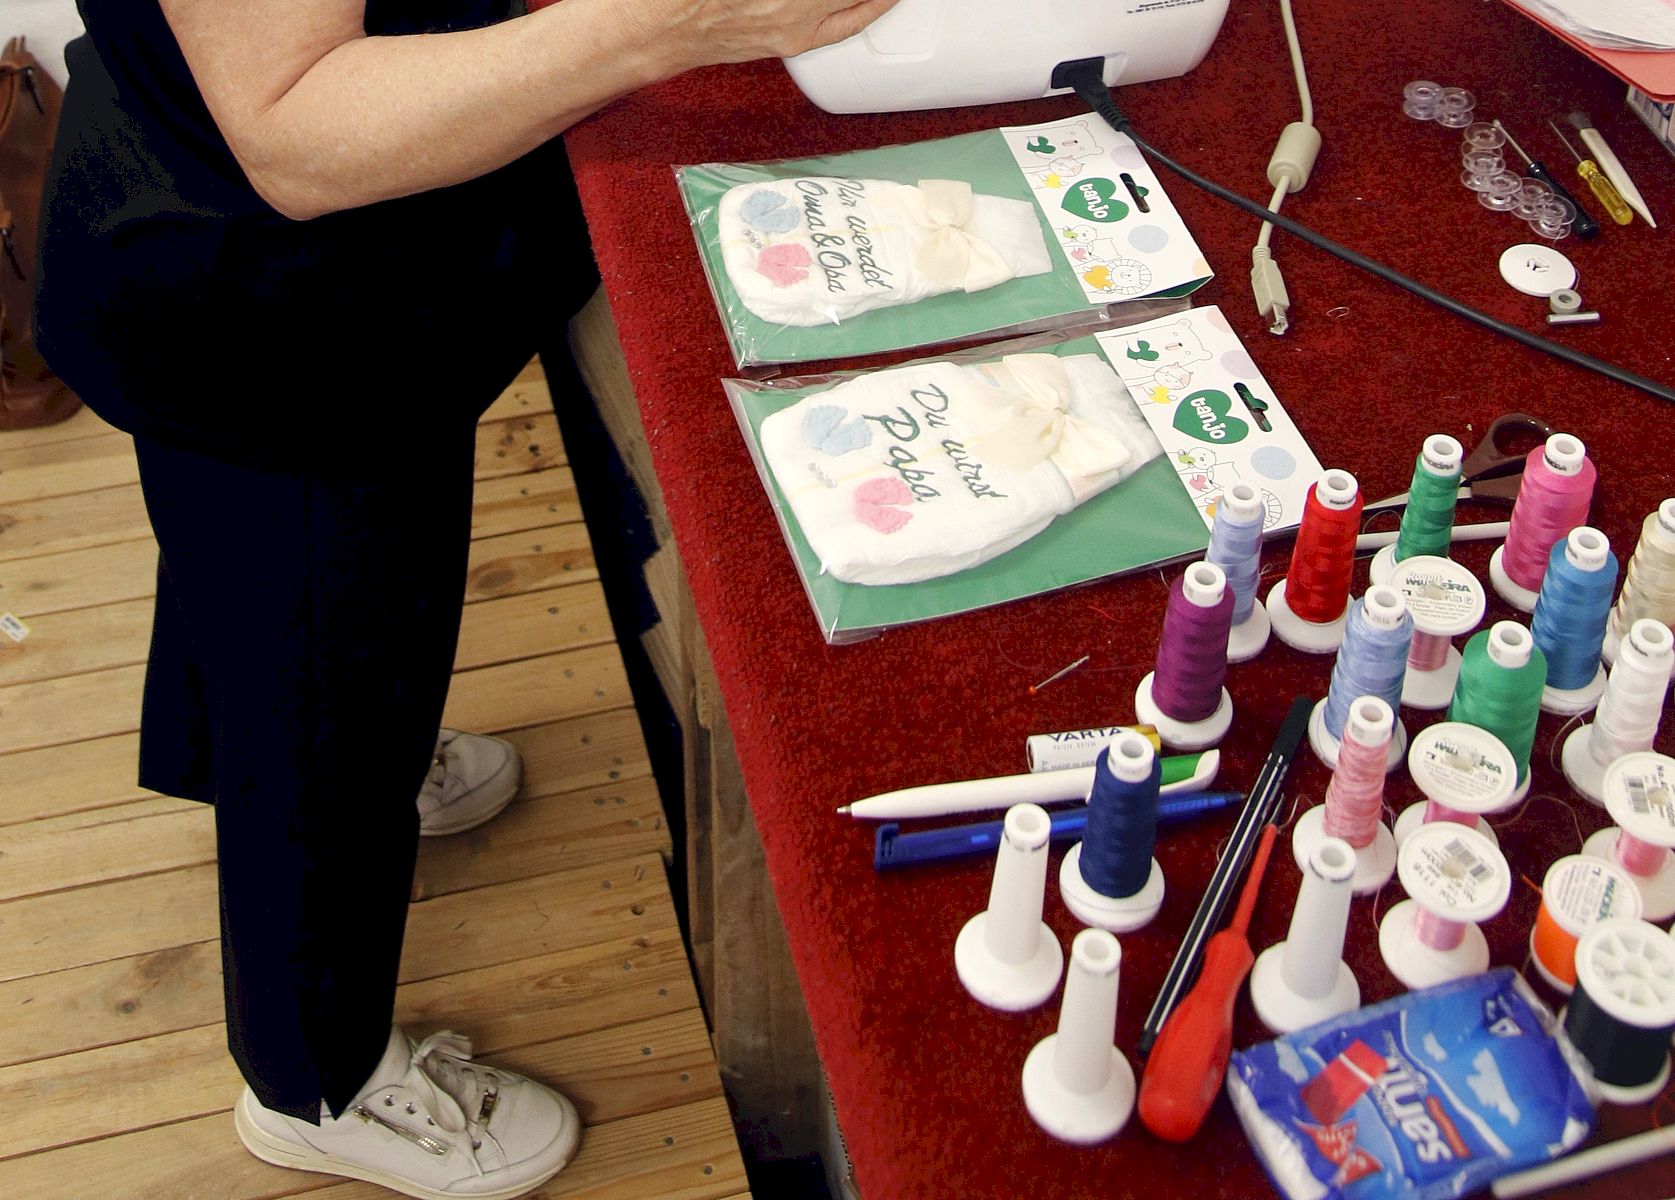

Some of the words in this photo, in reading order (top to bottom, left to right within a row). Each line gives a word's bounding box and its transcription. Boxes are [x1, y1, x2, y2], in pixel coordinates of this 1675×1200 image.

[1079, 183, 1109, 221] tanjo
[911, 383, 952, 430] Du
[1191, 396, 1226, 442] tanjo
[1048, 726, 1122, 742] VARTA
